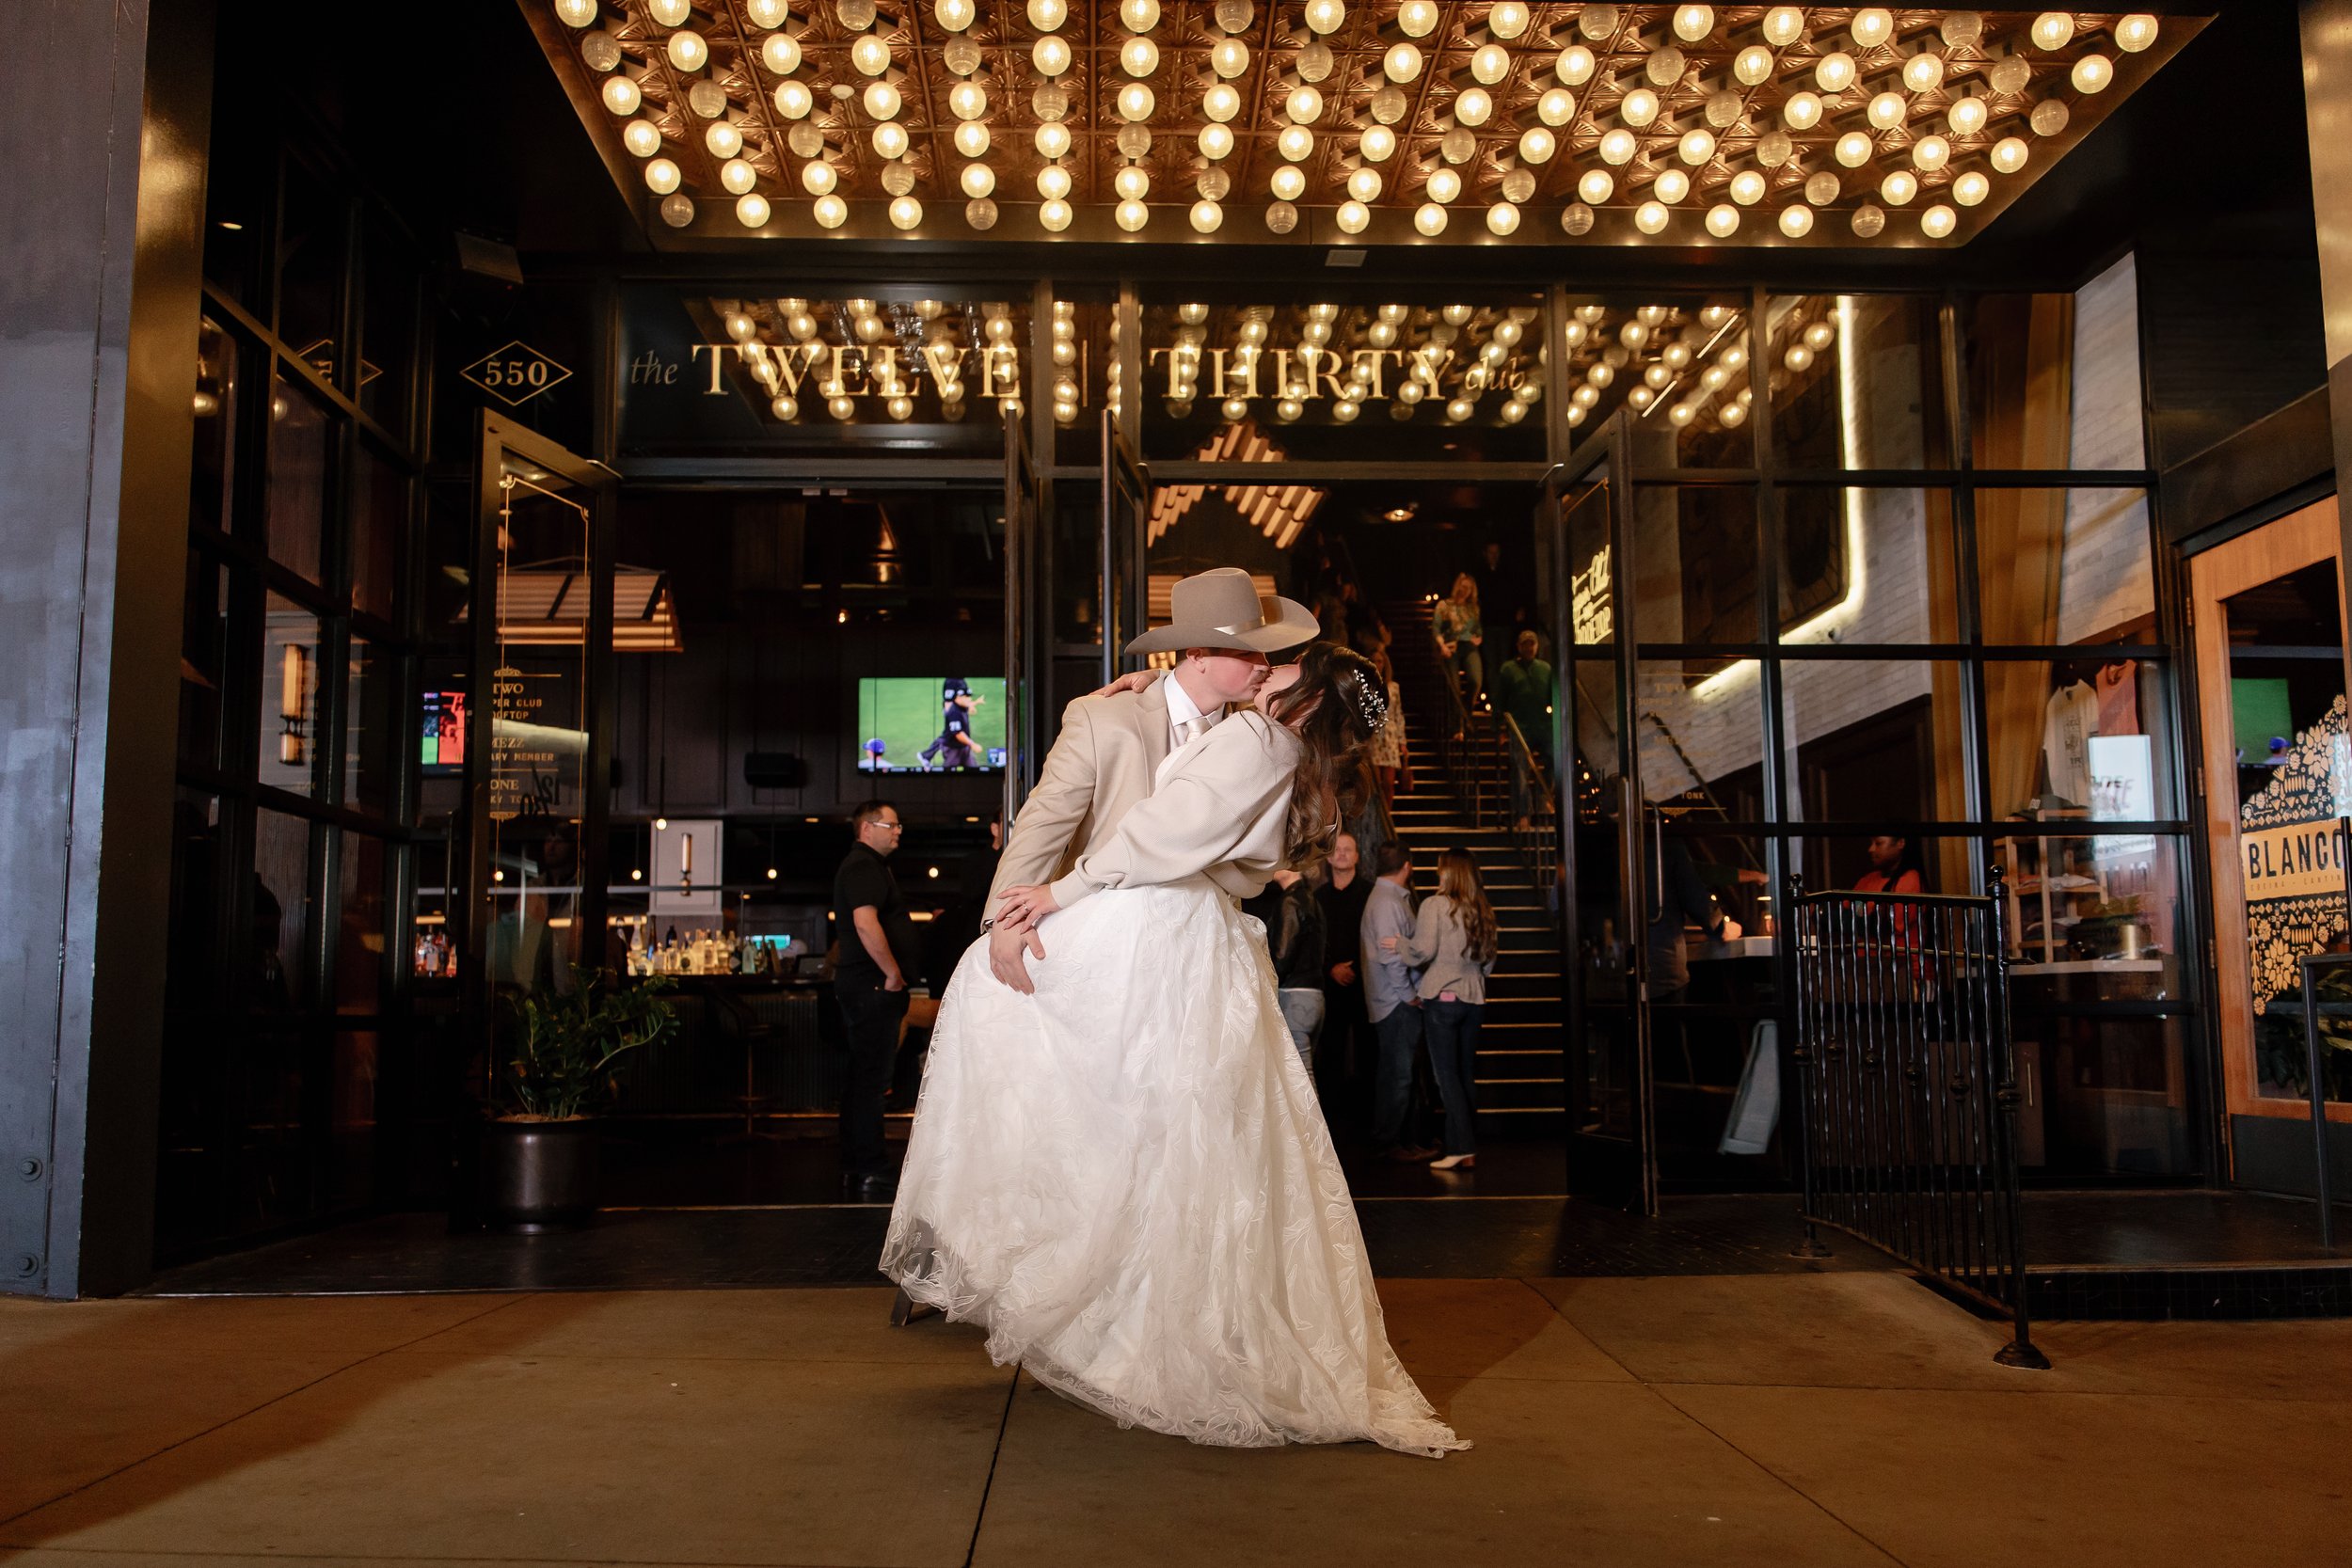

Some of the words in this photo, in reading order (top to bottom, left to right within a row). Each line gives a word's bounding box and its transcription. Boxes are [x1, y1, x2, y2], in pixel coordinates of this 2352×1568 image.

[485, 360, 548, 387] 550
[630, 349, 678, 385] the
[691, 344, 1020, 398] TWELVE
[1149, 348, 1456, 401] THIRTY
[1465, 356, 1525, 390] club
[516, 698, 542, 707] CLUB
[490, 780, 519, 790] ONE
[2303, 874, 2342, 884] CANTIN
